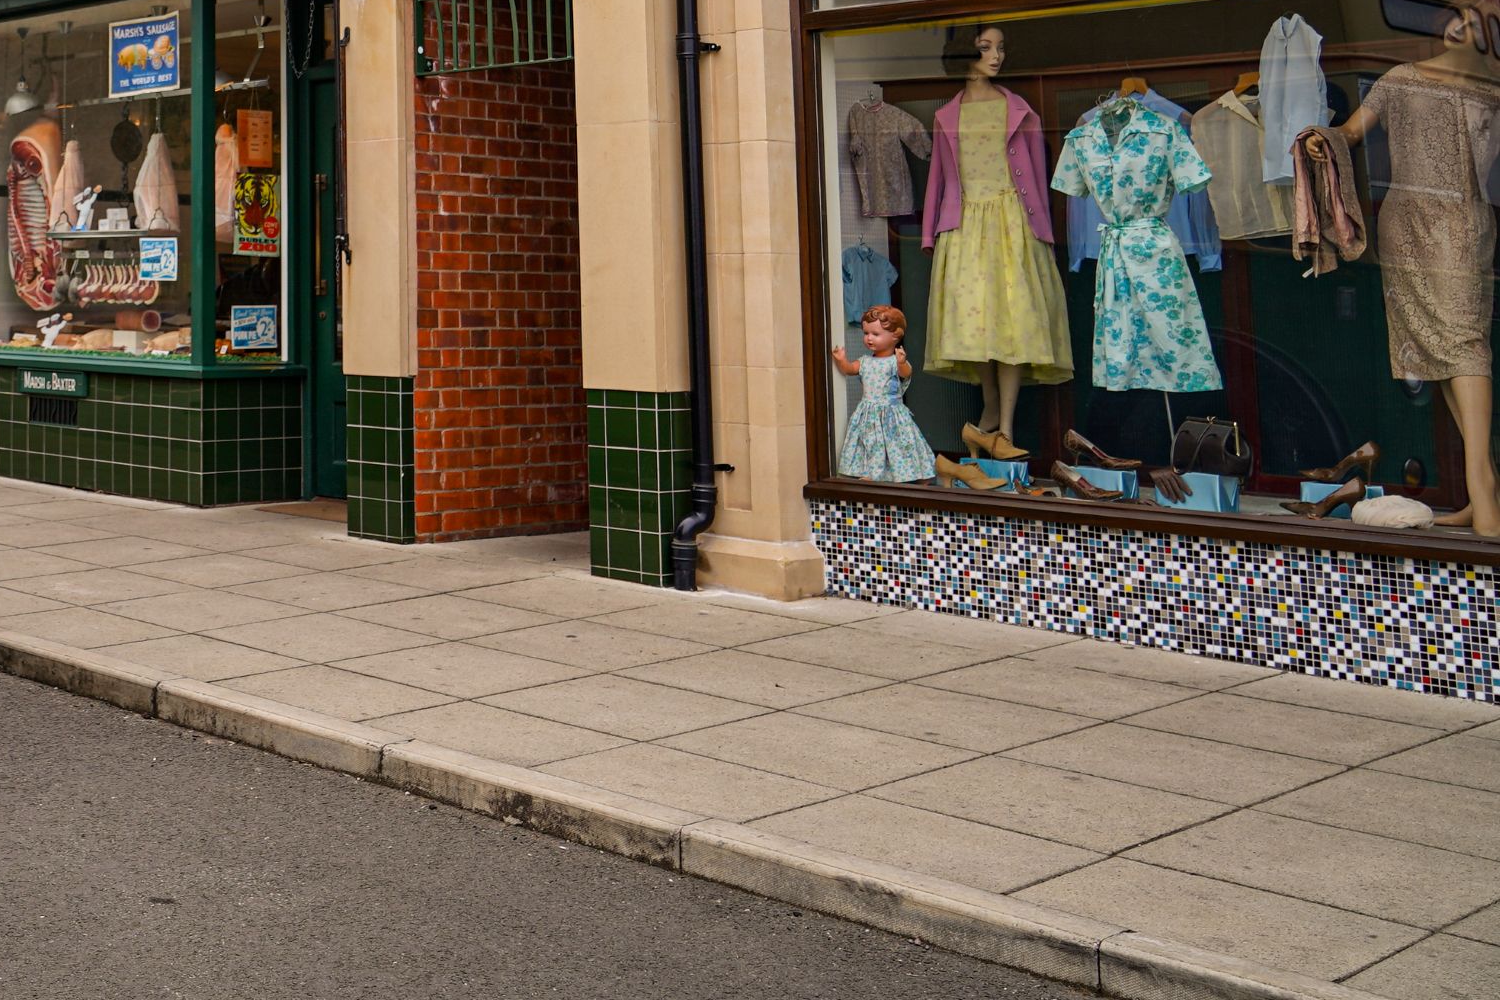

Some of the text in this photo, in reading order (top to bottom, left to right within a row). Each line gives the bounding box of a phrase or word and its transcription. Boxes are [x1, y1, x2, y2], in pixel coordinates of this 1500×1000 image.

[113, 20, 176, 40] MARSH'S SAUSAGE
[119, 79, 129, 87] THE
[131, 75, 156, 85] WORLD'S
[157, 73, 173, 82] BEST
[238, 242, 277, 252] ZOO
[23, 371, 46, 389] MARSH
[52, 372, 76, 391] BAXTER
